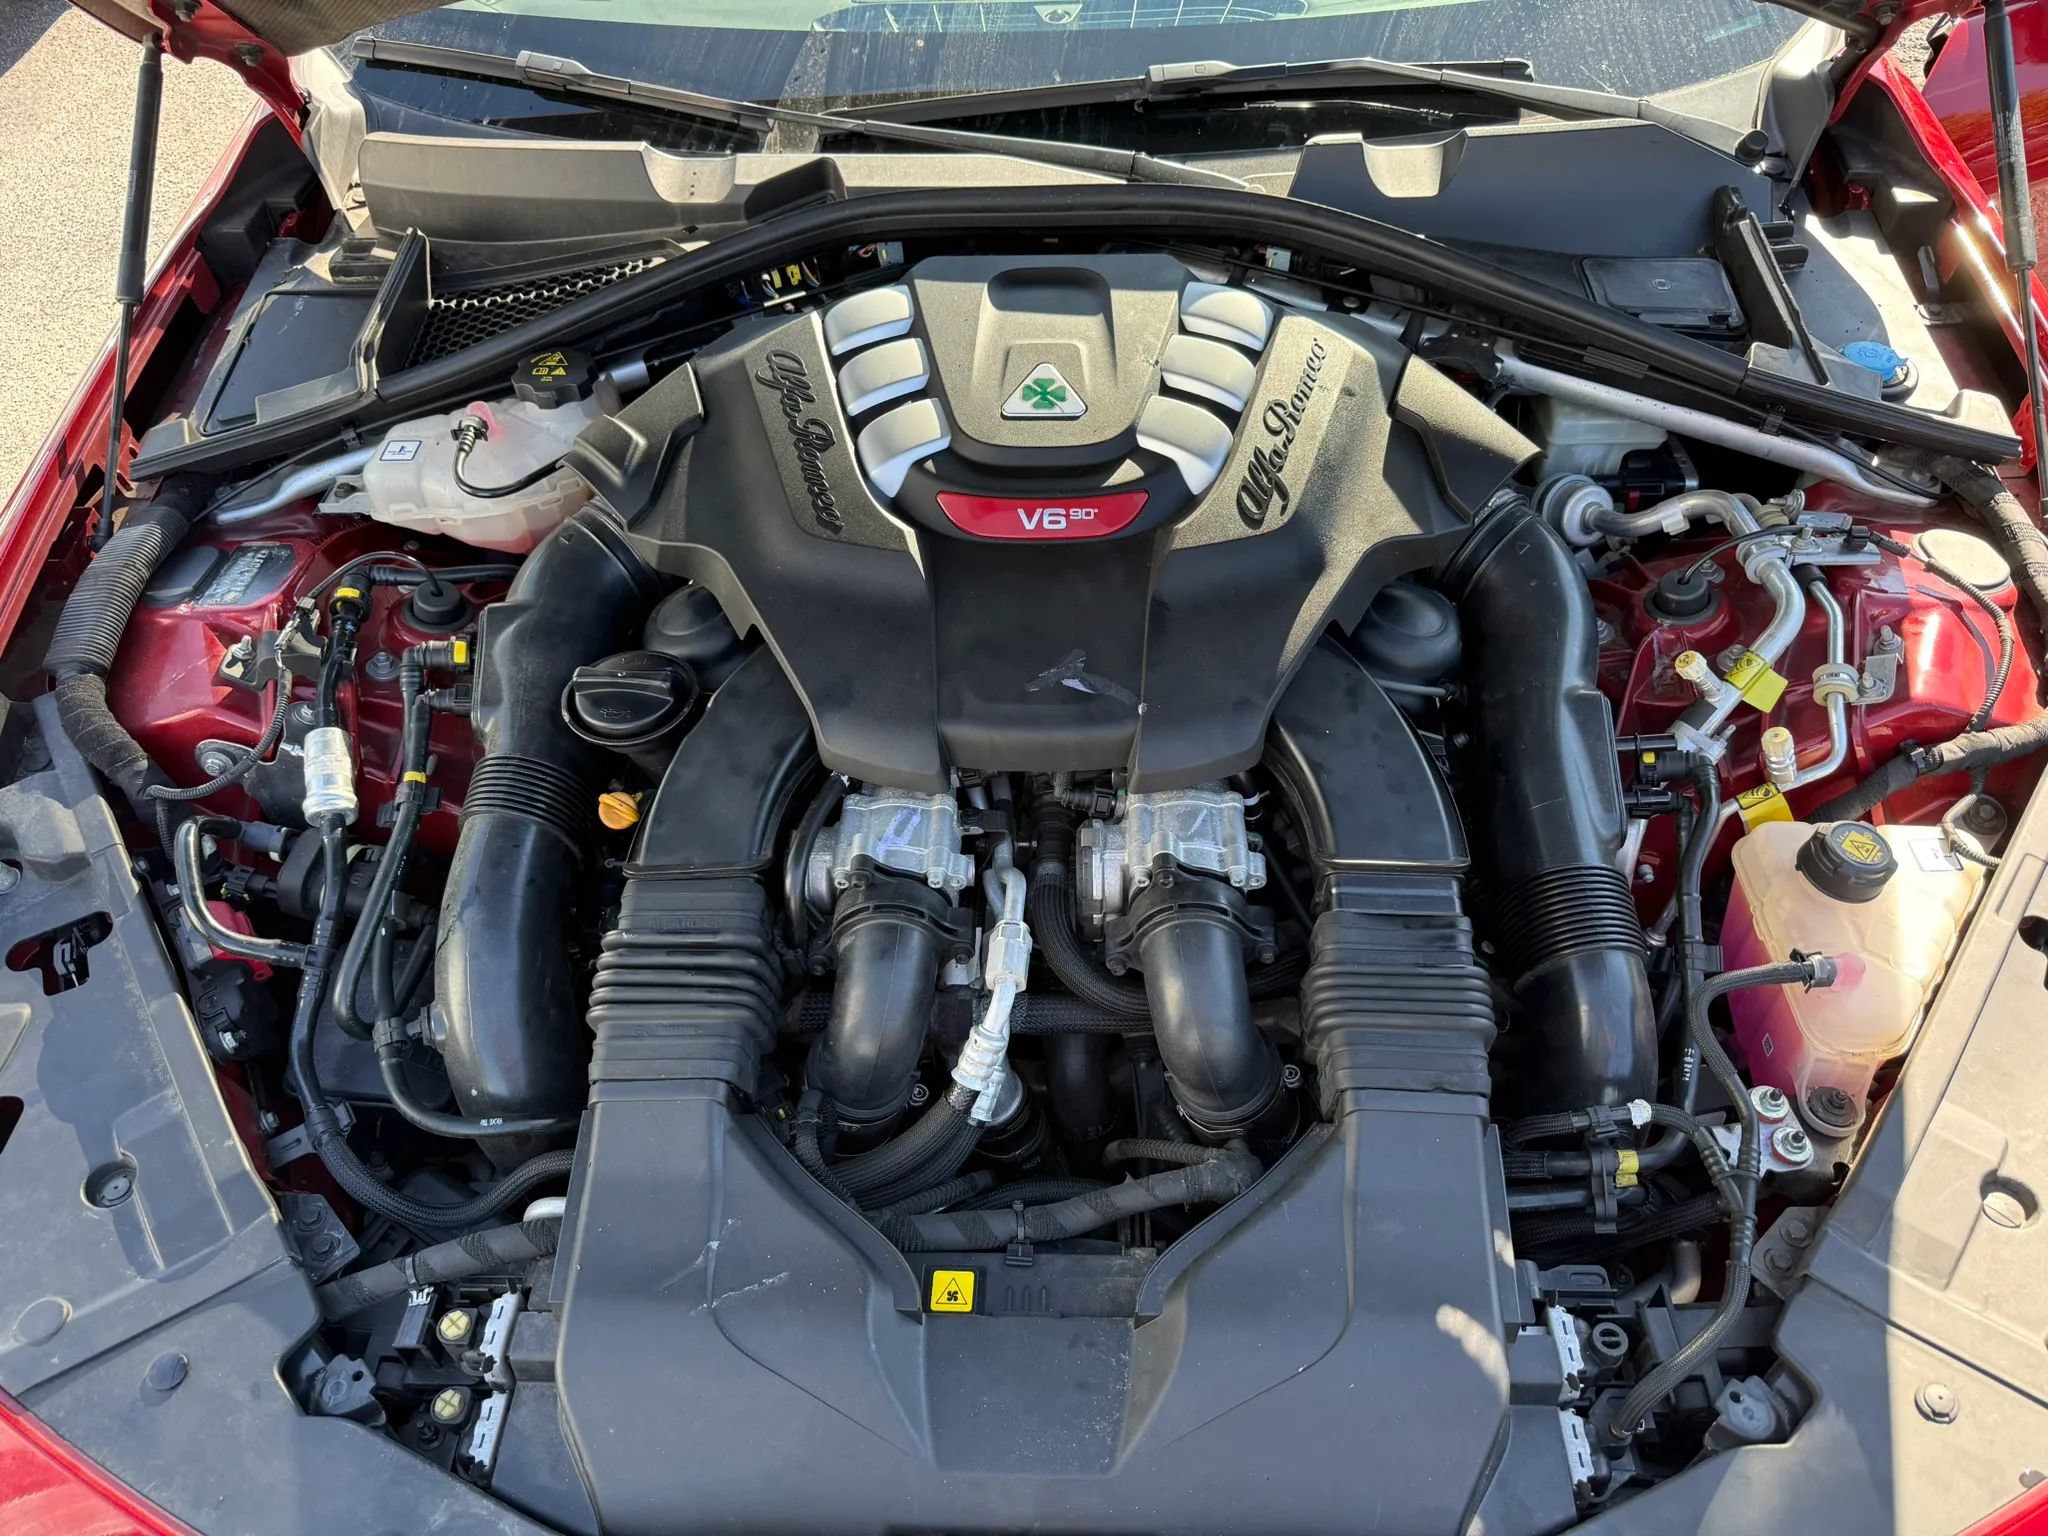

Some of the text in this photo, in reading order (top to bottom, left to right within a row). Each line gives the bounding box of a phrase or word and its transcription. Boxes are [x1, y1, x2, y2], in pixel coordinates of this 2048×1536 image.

[755, 350, 845, 535] Alfa Romeo
[1017, 508, 1067, 530] V6
[1236, 338, 1327, 529] Alfa Romeo
